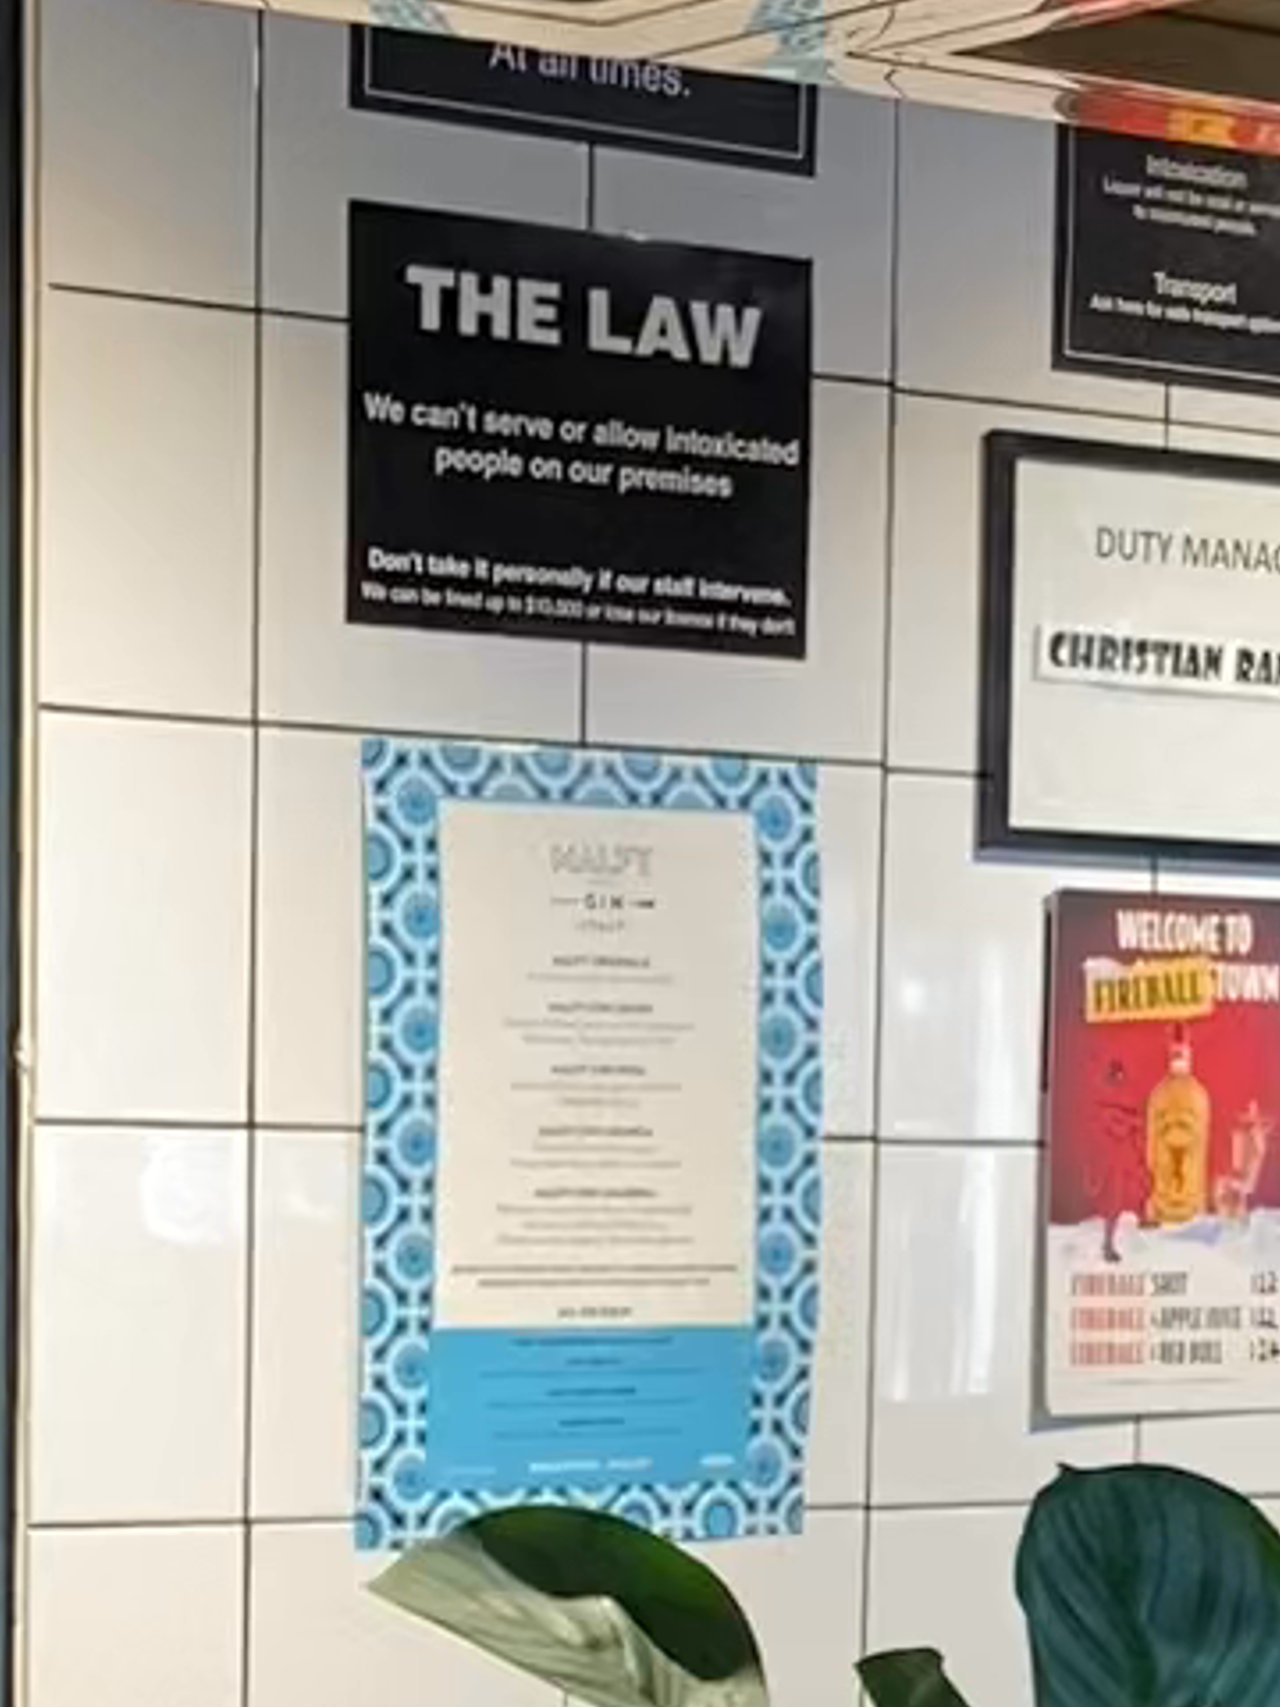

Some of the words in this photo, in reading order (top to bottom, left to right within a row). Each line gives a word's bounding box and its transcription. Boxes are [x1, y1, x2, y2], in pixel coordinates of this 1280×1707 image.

[1153, 271, 1237, 306] Transport
[405, 263, 561, 346] THE
[588, 287, 762, 368] LAW
[364, 392, 405, 426] We
[411, 401, 476, 433] can't
[483, 410, 554, 441] serve
[559, 419, 587, 443] or
[593, 418, 660, 451] allow
[435, 446, 523, 481] people
[529, 456, 562, 481] on
[568, 459, 614, 484] our
[618, 463, 733, 499] premises
[1095, 525, 1173, 565] DUTY
[368, 545, 423, 576] Don't
[428, 554, 470, 579] take
[474, 558, 489, 581] it
[493, 562, 593, 595] personally
[598, 568, 612, 591] if
[616, 574, 650, 594] our
[653, 574, 695, 597] staff
[389, 587, 419, 605] can
[421, 588, 441, 607] be
[1048, 630, 1224, 683] CHRISTIAN
[585, 893, 624, 911] GIN
[1117, 909, 1220, 954] WELCOME
[1225, 913, 1253, 955] TO
[1093, 971, 1202, 1014] FIREBALL
